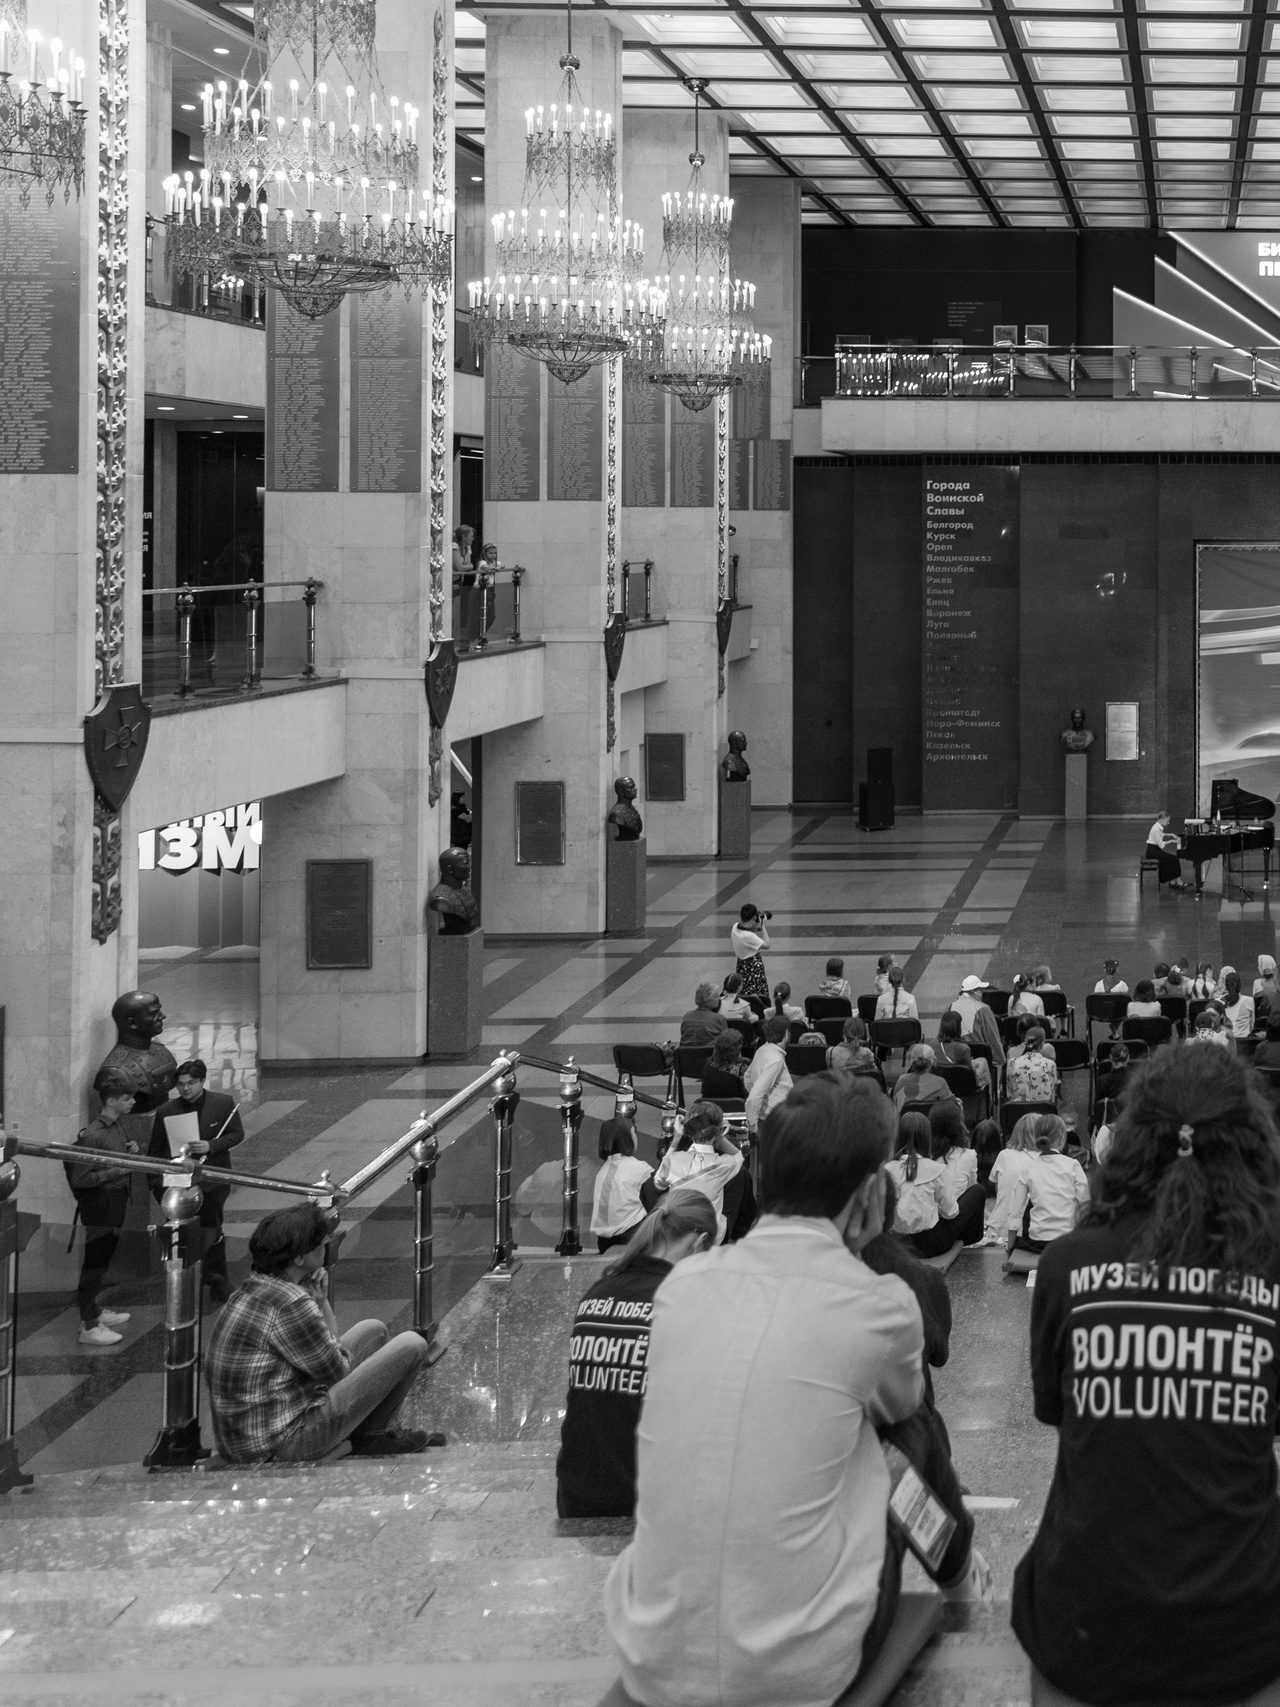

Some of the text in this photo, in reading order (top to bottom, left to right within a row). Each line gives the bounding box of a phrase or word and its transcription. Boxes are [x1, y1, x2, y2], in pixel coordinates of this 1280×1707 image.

[926, 481, 970, 491] Города
[926, 493, 984, 503] Воинской
[926, 506, 965, 515] Славы
[926, 521, 973, 530] Белгород
[926, 532, 956, 540] Курск
[926, 543, 952, 552] Орел
[926, 554, 992, 562] Владикавказ
[926, 564, 974, 573] Малгобек
[926, 576, 952, 584] Ржев
[926, 587, 954, 595] Ельня
[926, 598, 950, 607] Елец
[926, 609, 972, 618] Воронеж
[926, 620, 950, 630] Луга
[926, 631, 977, 640] Полярный
[926, 719, 1000, 730] Наро-Фоминск
[926, 742, 971, 750] Козельск
[926, 753, 988, 762] Архангельск
[1070, 1260, 1159, 1296] МУЗЕЙ
[613, 1301, 652, 1320] ПОБЕ
[570, 1334, 650, 1366] ОЛОНТЁ
[1072, 1324, 1274, 1380] ВОЛОНТЁР
[570, 1364, 648, 1394] LUNTEE
[1073, 1376, 1269, 1426] VOLUNTEER
